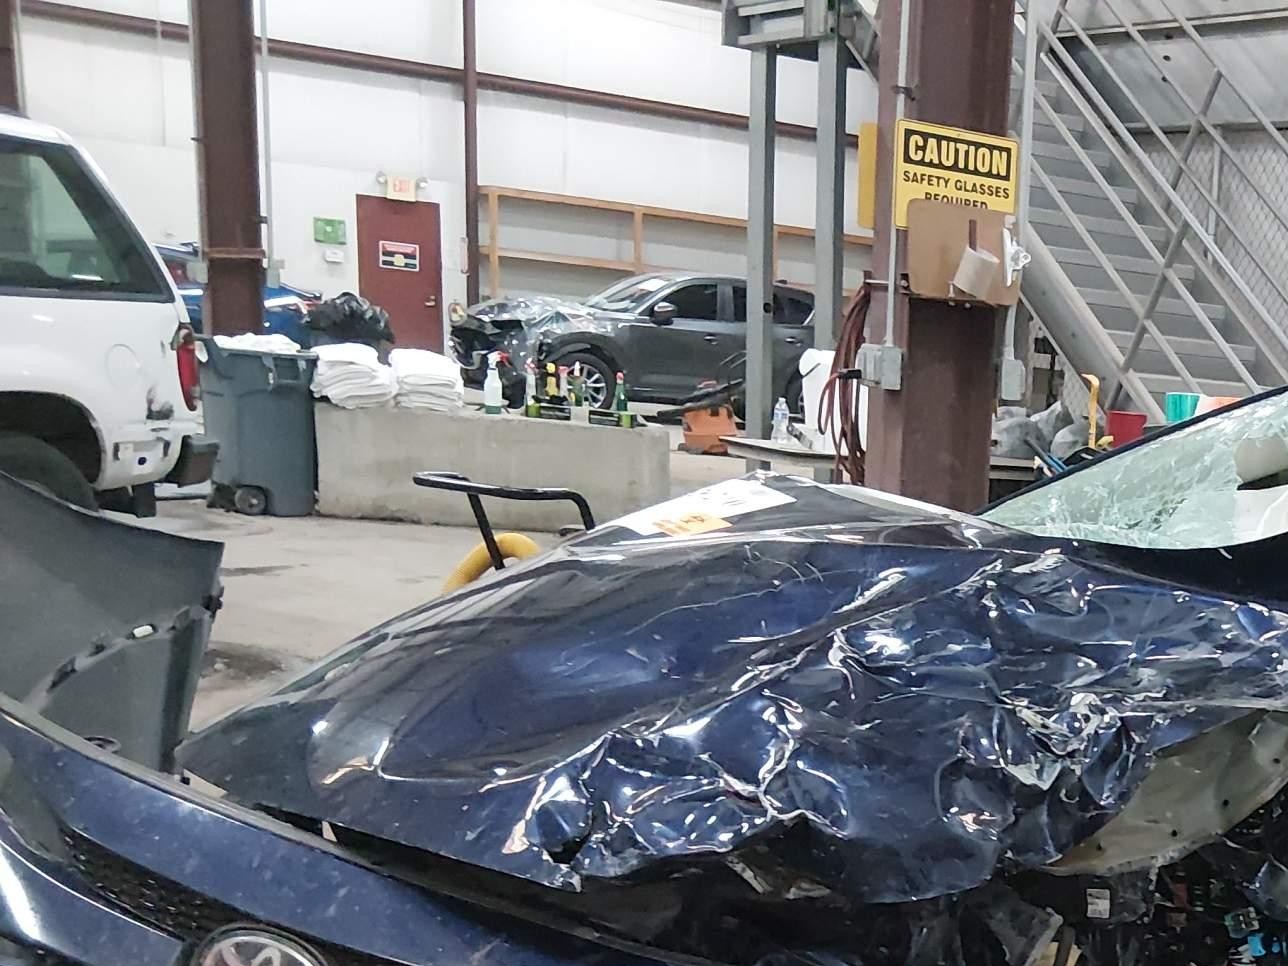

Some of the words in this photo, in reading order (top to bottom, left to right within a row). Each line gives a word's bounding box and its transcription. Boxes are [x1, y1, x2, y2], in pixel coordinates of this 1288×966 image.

[908, 134, 1008, 176] CAUTION
[903, 170, 951, 188] SAFETY
[955, 180, 1010, 199] GLASSES
